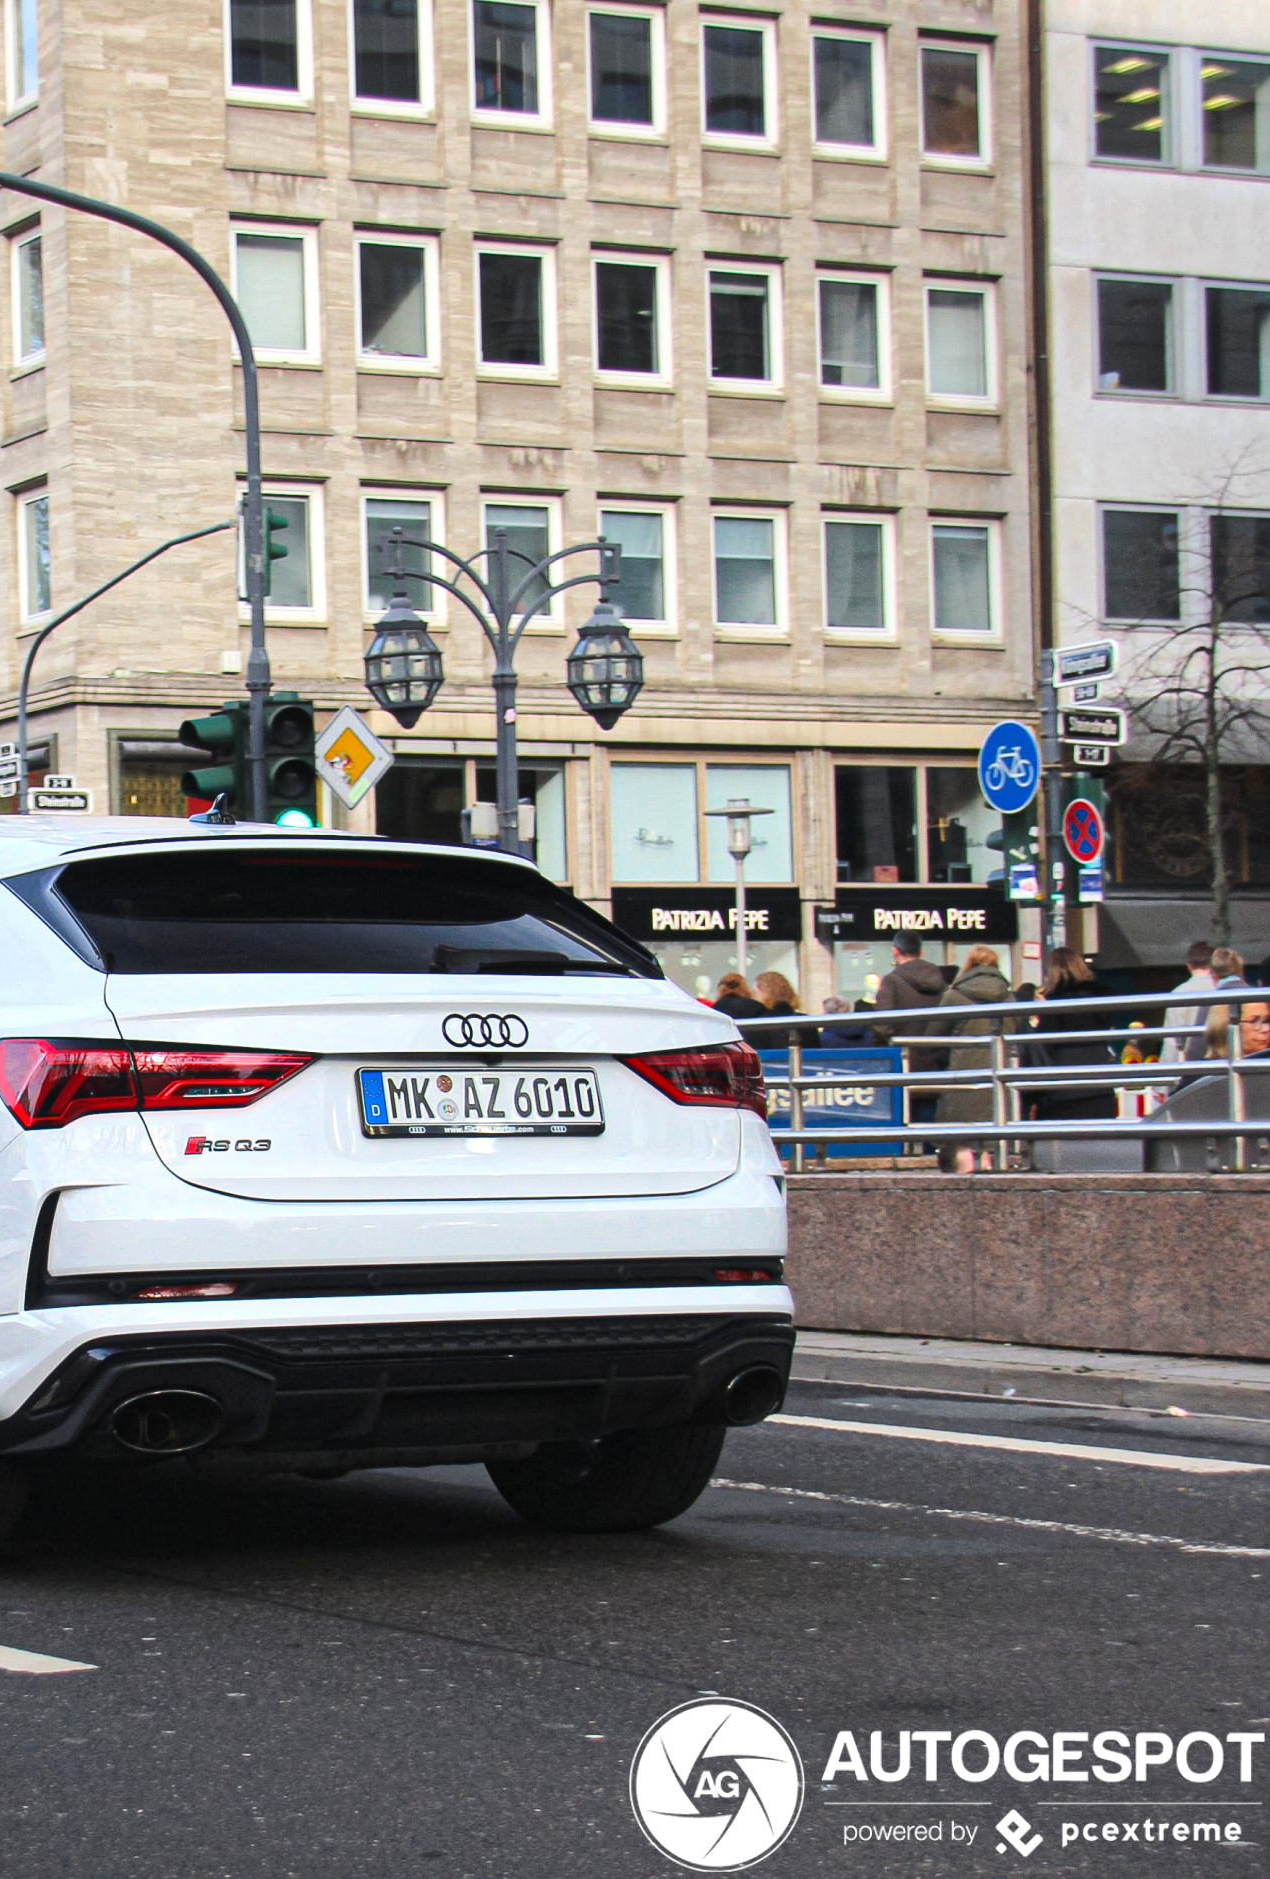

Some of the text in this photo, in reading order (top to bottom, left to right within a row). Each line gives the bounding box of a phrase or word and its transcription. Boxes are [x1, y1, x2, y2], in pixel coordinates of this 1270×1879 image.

[652, 908, 769, 930] PATRIZIA PEPE
[874, 908, 943, 930] PATRIZIA
[947, 908, 986, 930] PEPE
[387, 1077, 595, 1118] MK AZ 6010
[192, 1138, 271, 1152] RS Q3
